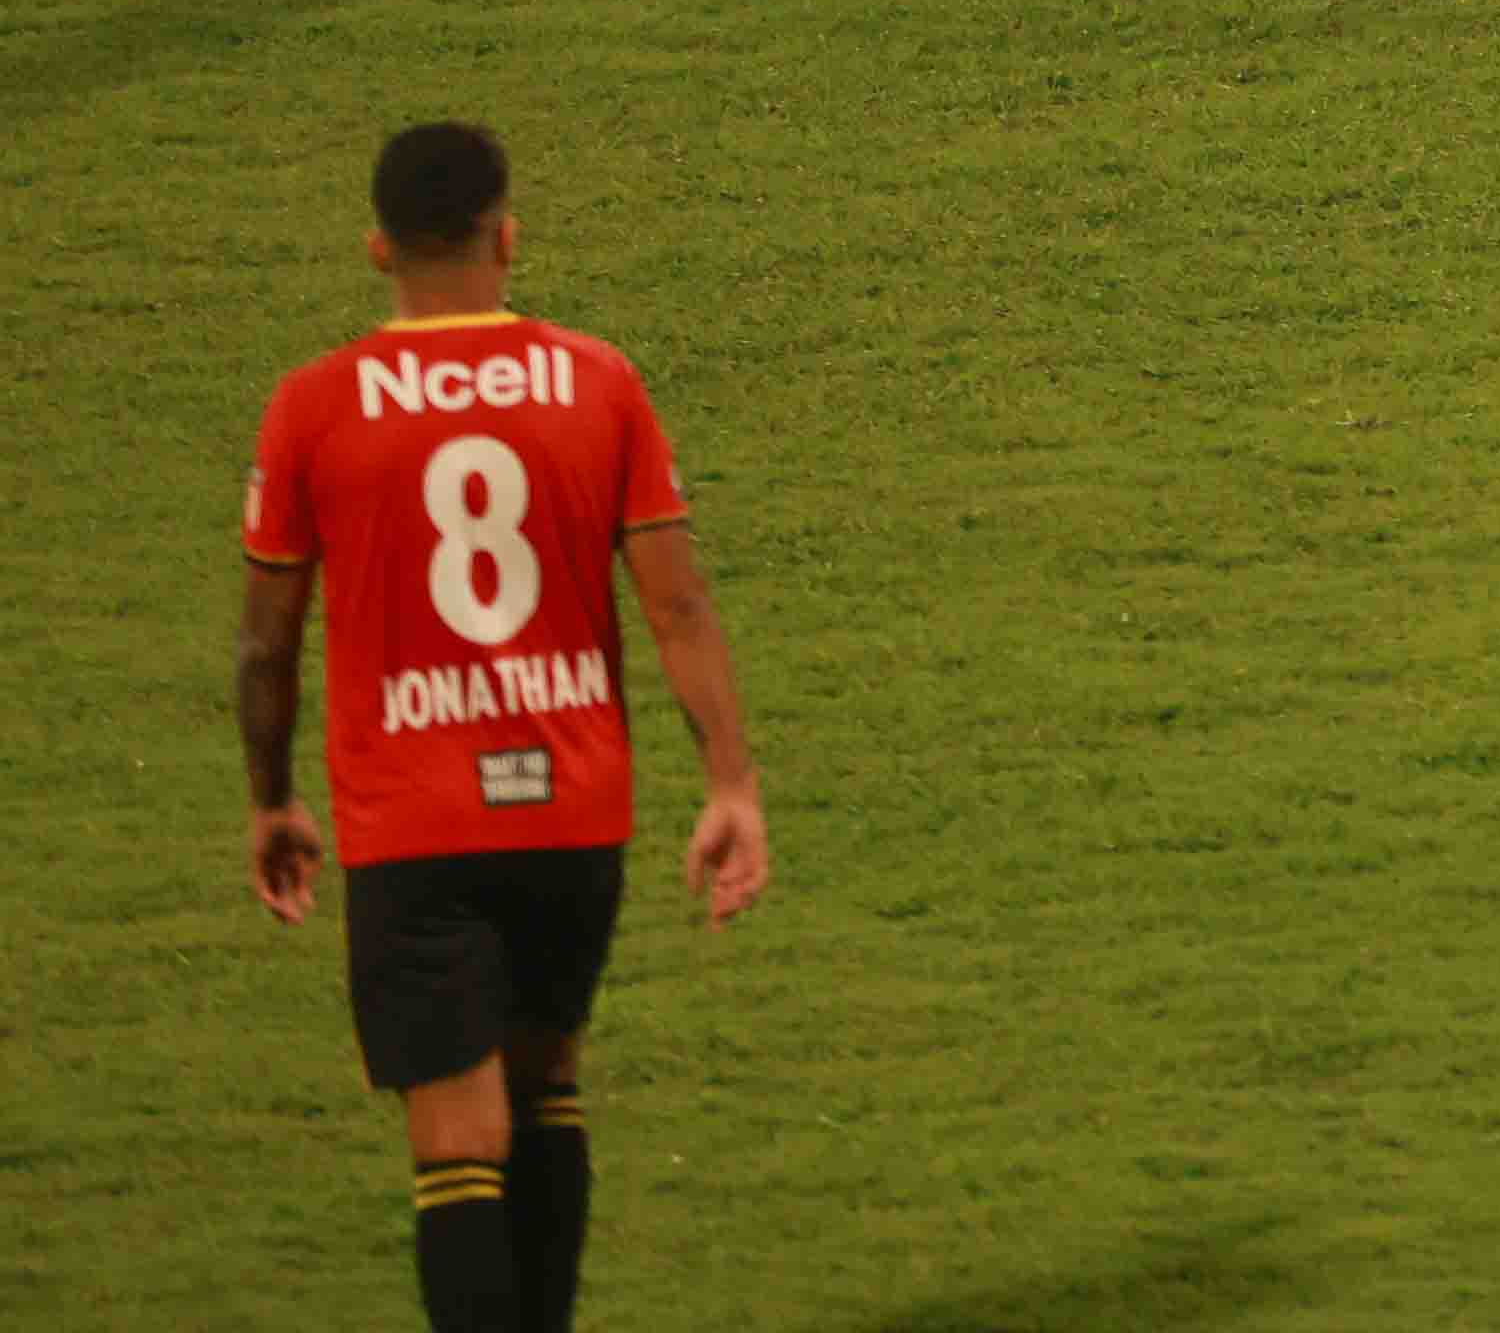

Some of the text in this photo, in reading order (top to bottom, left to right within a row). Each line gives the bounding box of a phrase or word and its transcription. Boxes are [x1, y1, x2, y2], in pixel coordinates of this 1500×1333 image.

[356, 344, 575, 420] Ncell
[423, 435, 541, 646] 8
[381, 648, 609, 734] JONATHAN
